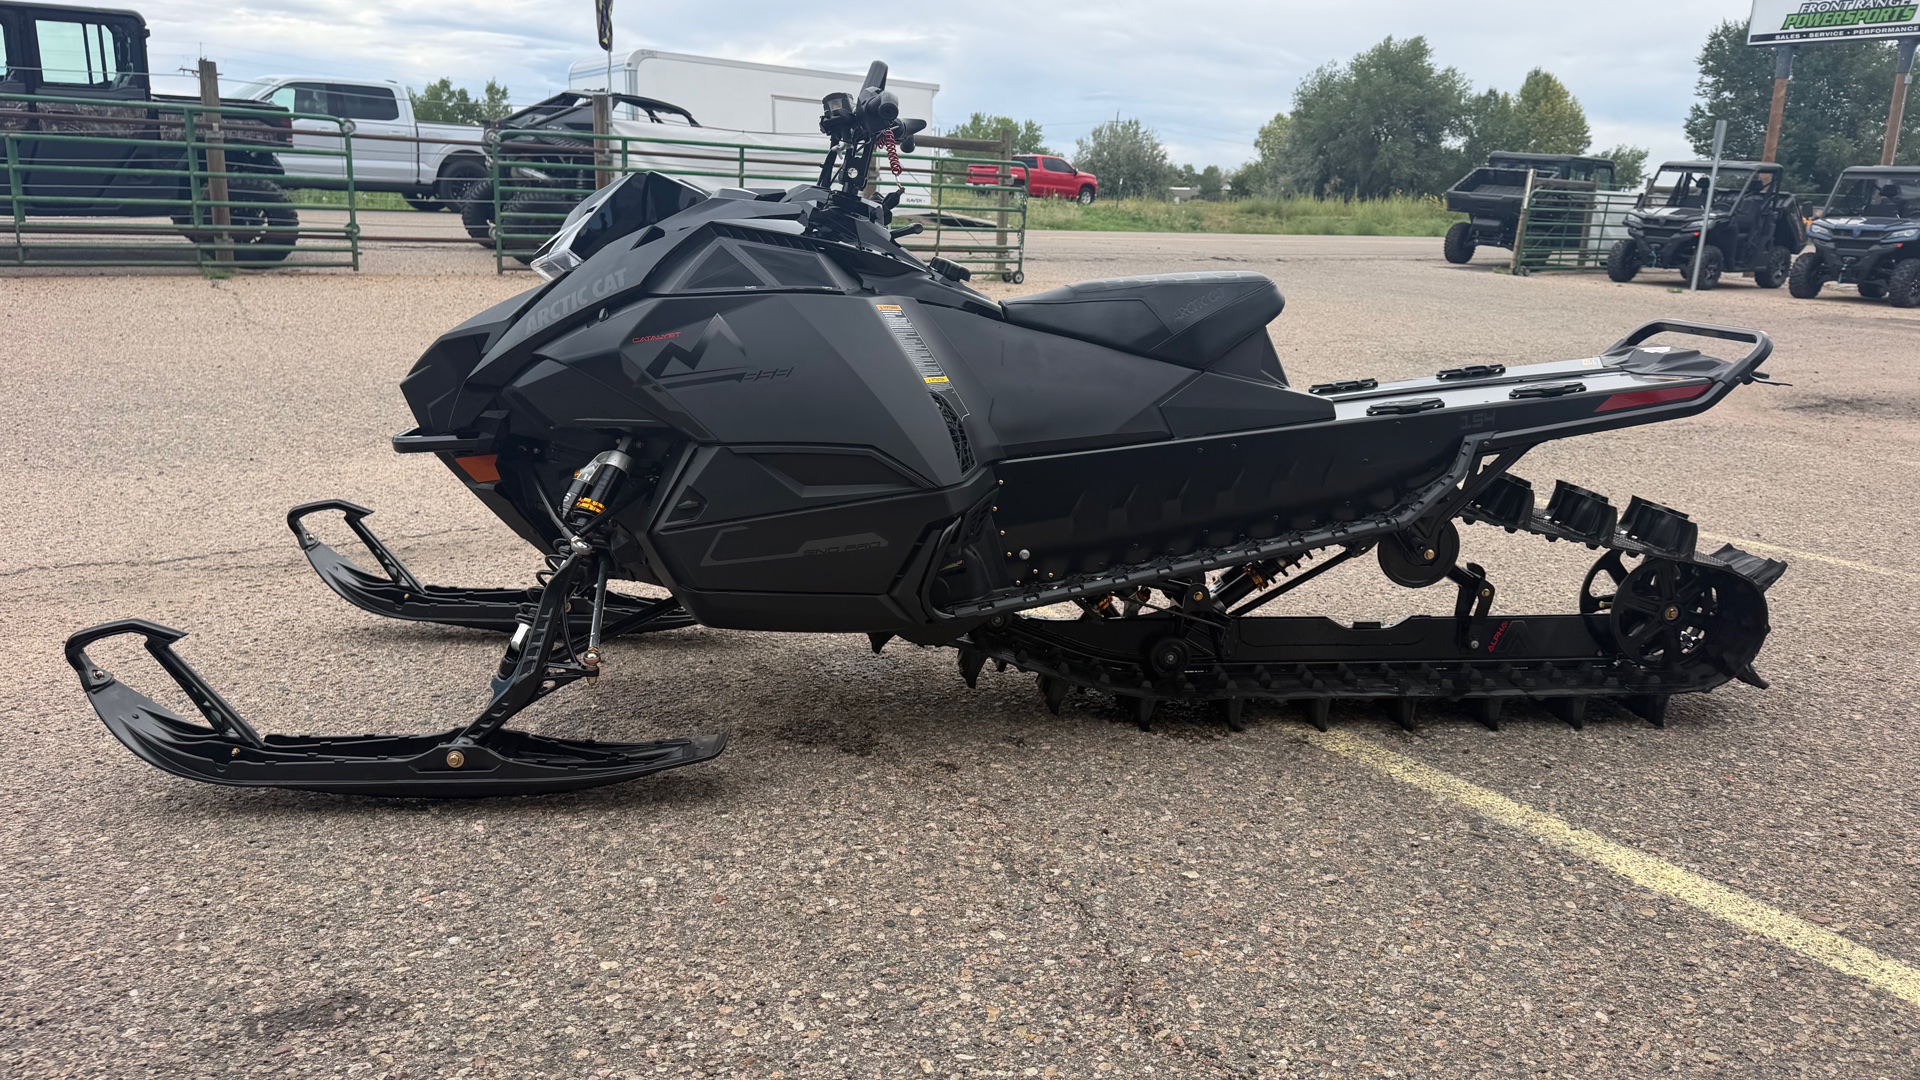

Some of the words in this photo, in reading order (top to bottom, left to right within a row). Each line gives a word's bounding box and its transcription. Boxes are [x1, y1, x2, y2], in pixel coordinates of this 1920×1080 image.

[1799, 1, 1851, 14] FRONT
[1781, 5, 1918, 30] POWERSPORTS
[1808, 30, 1844, 38] SERVICE
[1853, 25, 1920, 35] PERFORMANCE
[525, 286, 588, 336] ARCTIC
[592, 267, 627, 298] CAT
[632, 331, 682, 344] CATALYST
[1460, 410, 1496, 430] 154
[844, 541, 881, 552] PRO
[1488, 621, 1508, 652] ALPHA
